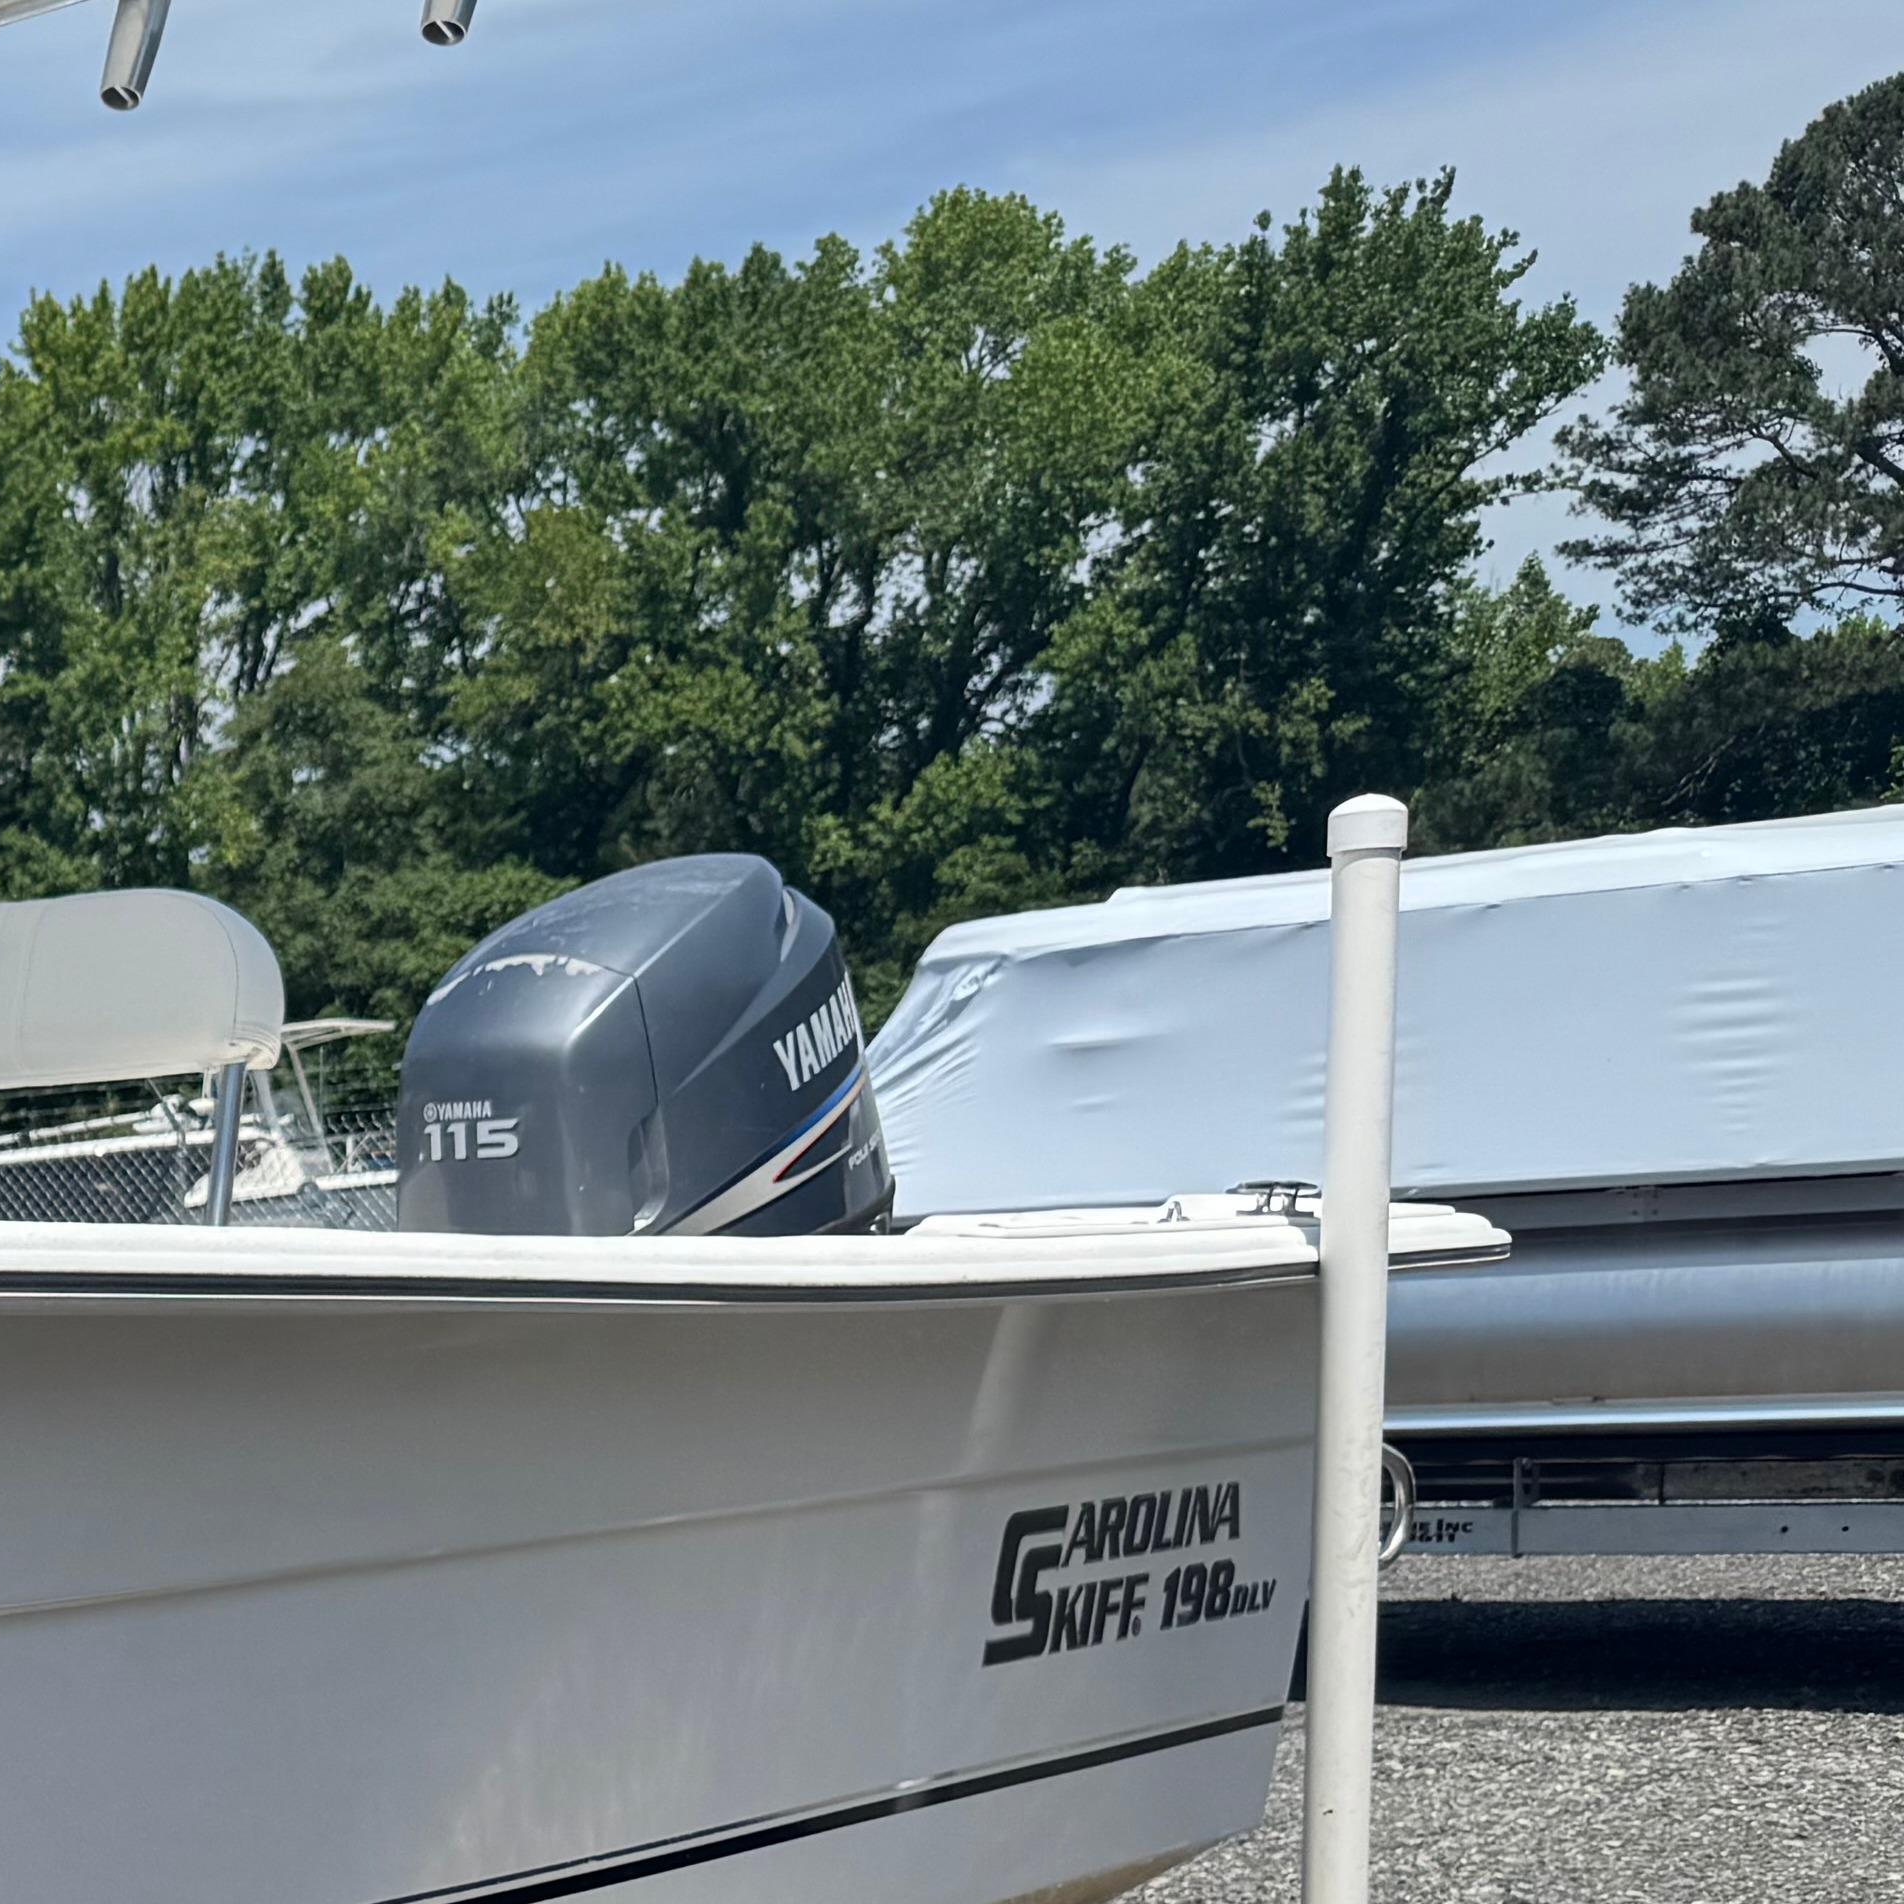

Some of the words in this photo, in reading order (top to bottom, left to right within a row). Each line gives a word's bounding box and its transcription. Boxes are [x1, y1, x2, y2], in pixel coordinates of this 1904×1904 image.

[424, 1118, 519, 1161] 115
[437, 1101, 492, 1120] YAMAHA
[992, 1481, 1241, 1626] CAROLINA
[982, 1544, 1149, 1667] SKIFF
